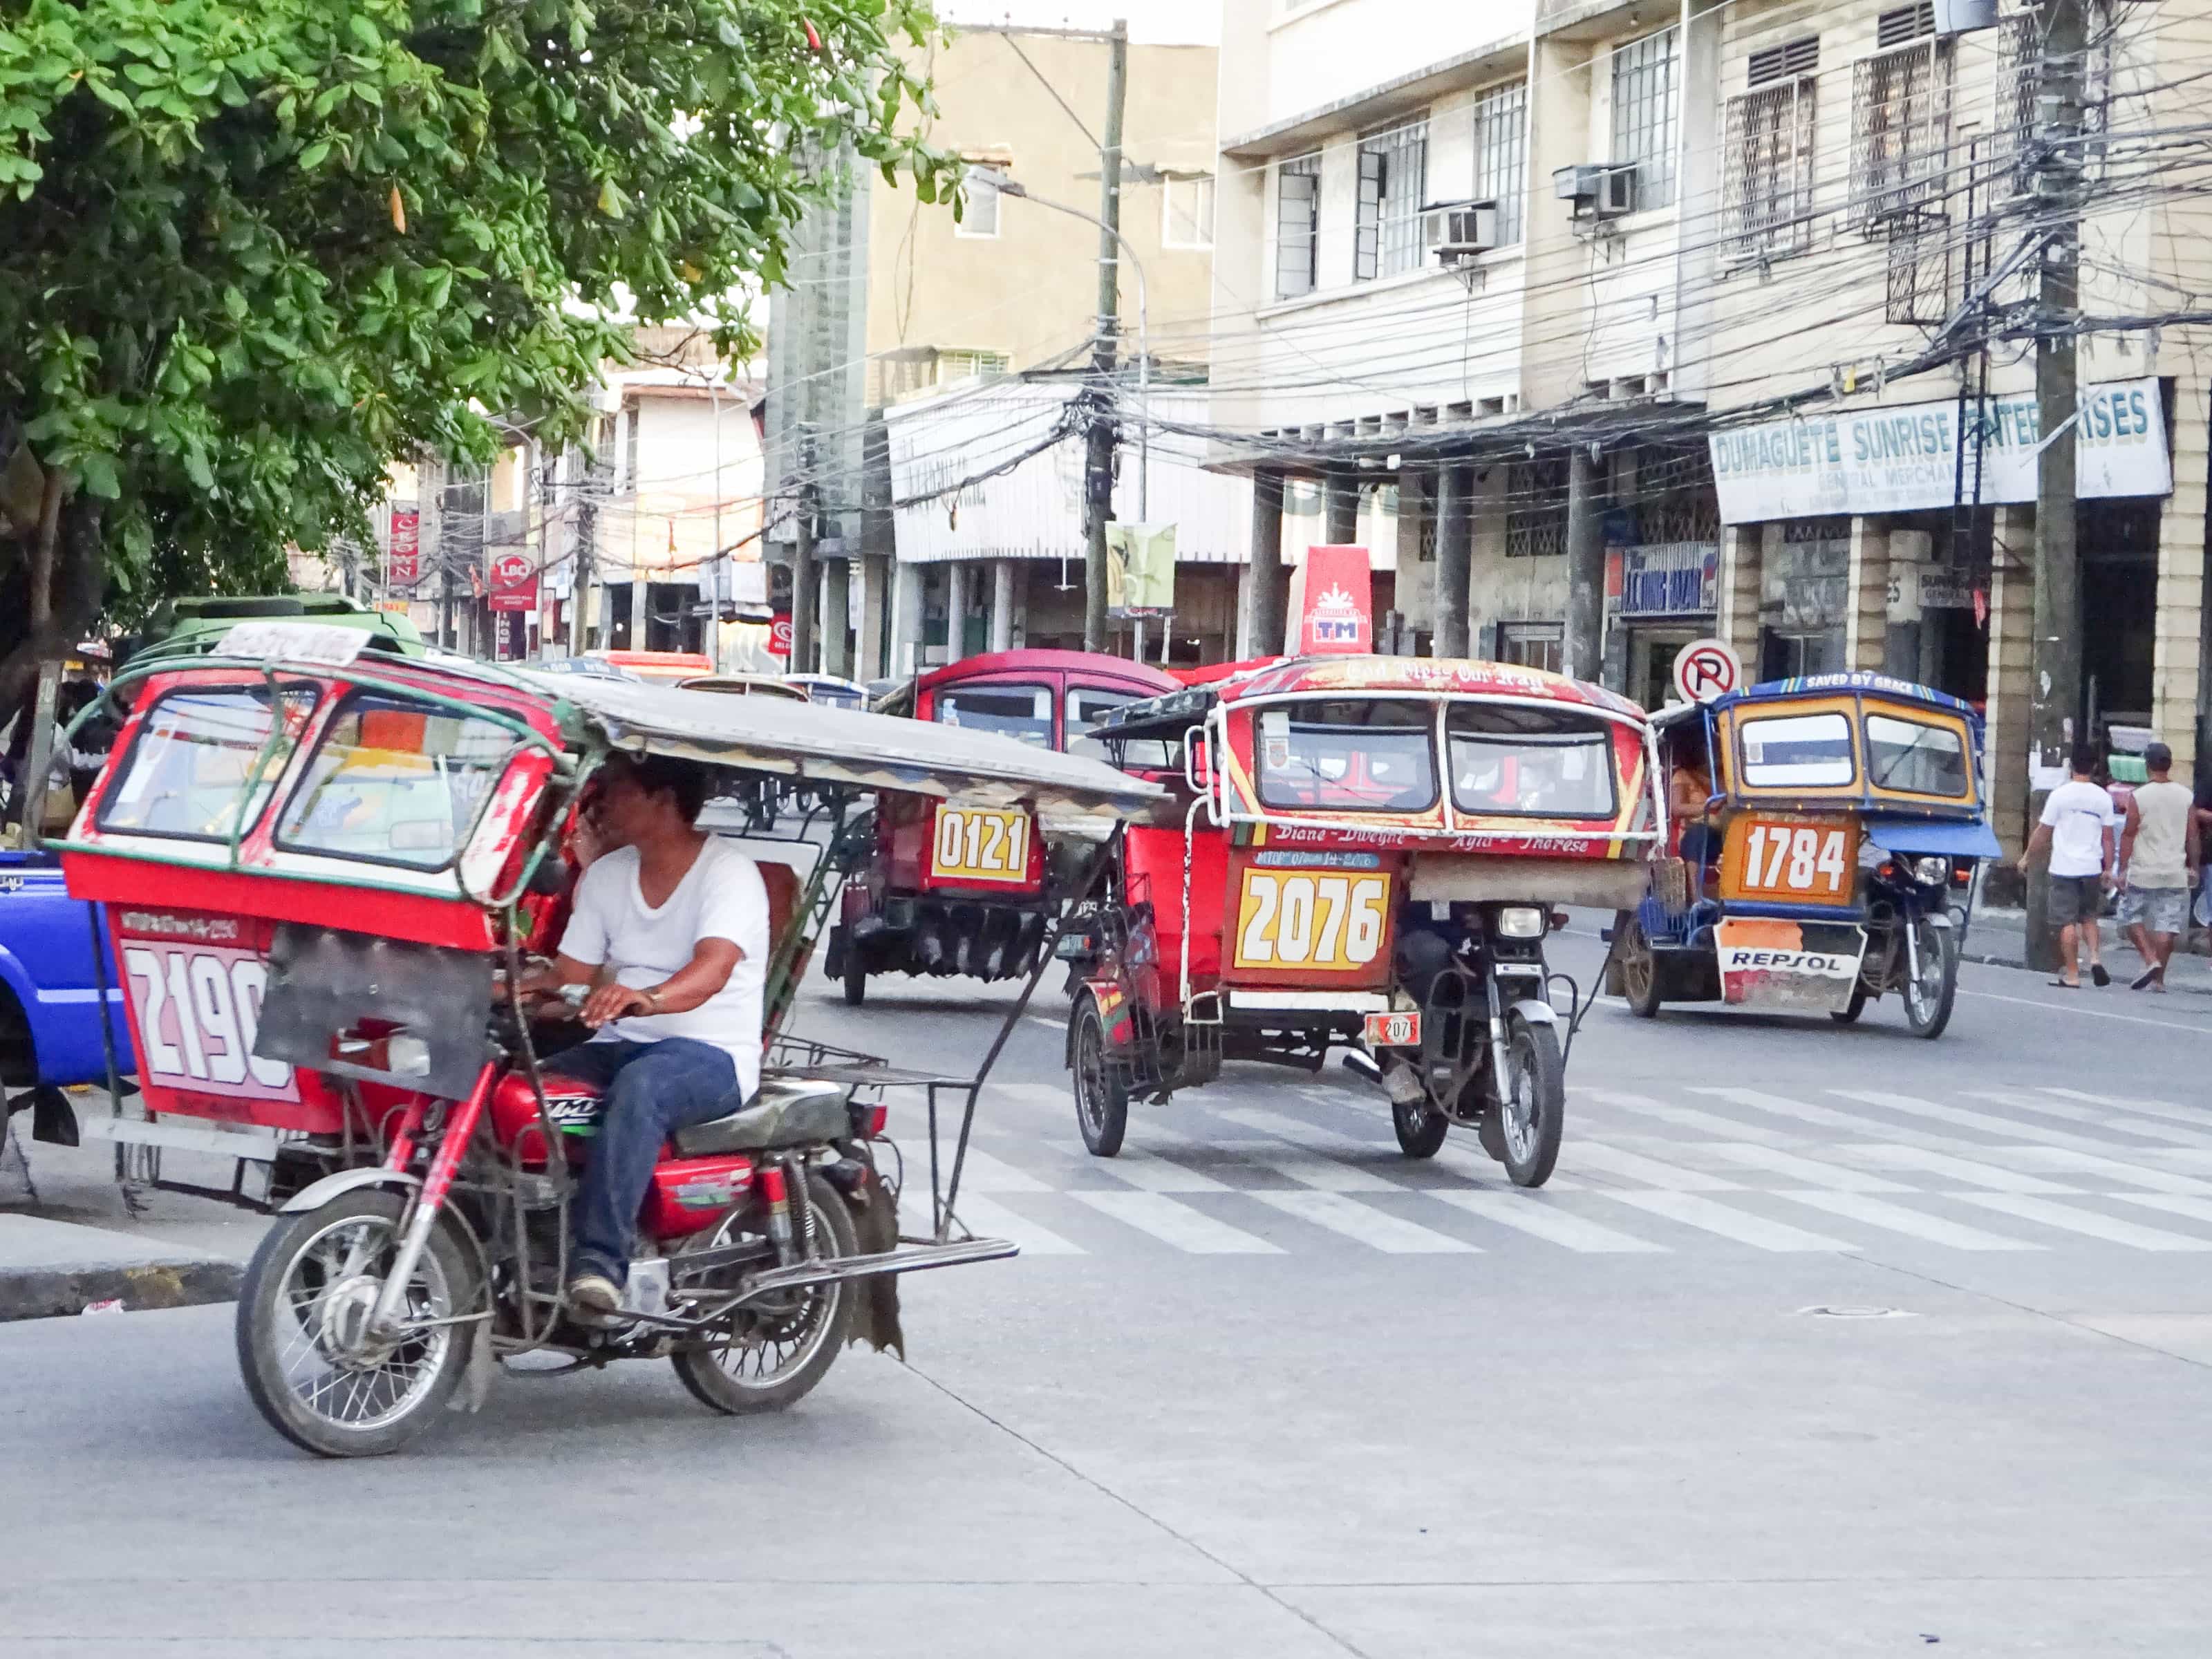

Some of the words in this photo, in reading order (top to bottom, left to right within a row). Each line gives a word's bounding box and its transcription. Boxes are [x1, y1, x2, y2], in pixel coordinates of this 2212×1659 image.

[1715, 421, 1841, 474] DUMAGUETE
[1853, 412, 1953, 461] SUNRISE
[1965, 389, 2148, 449] ENTERISES
[500, 563, 527, 577] LBC
[1318, 622, 1357, 639] TM
[1457, 662, 1493, 682] Our
[1806, 673, 1849, 688] SAVED
[1850, 673, 1872, 686] BY
[1873, 676, 1914, 695] GRACE
[939, 812, 1025, 871] 0121
[1275, 824, 1327, 841] Diane
[1745, 825, 1846, 892] 1784
[1241, 874, 1384, 963] 2076
[1732, 952, 1841, 971] REPSOL
